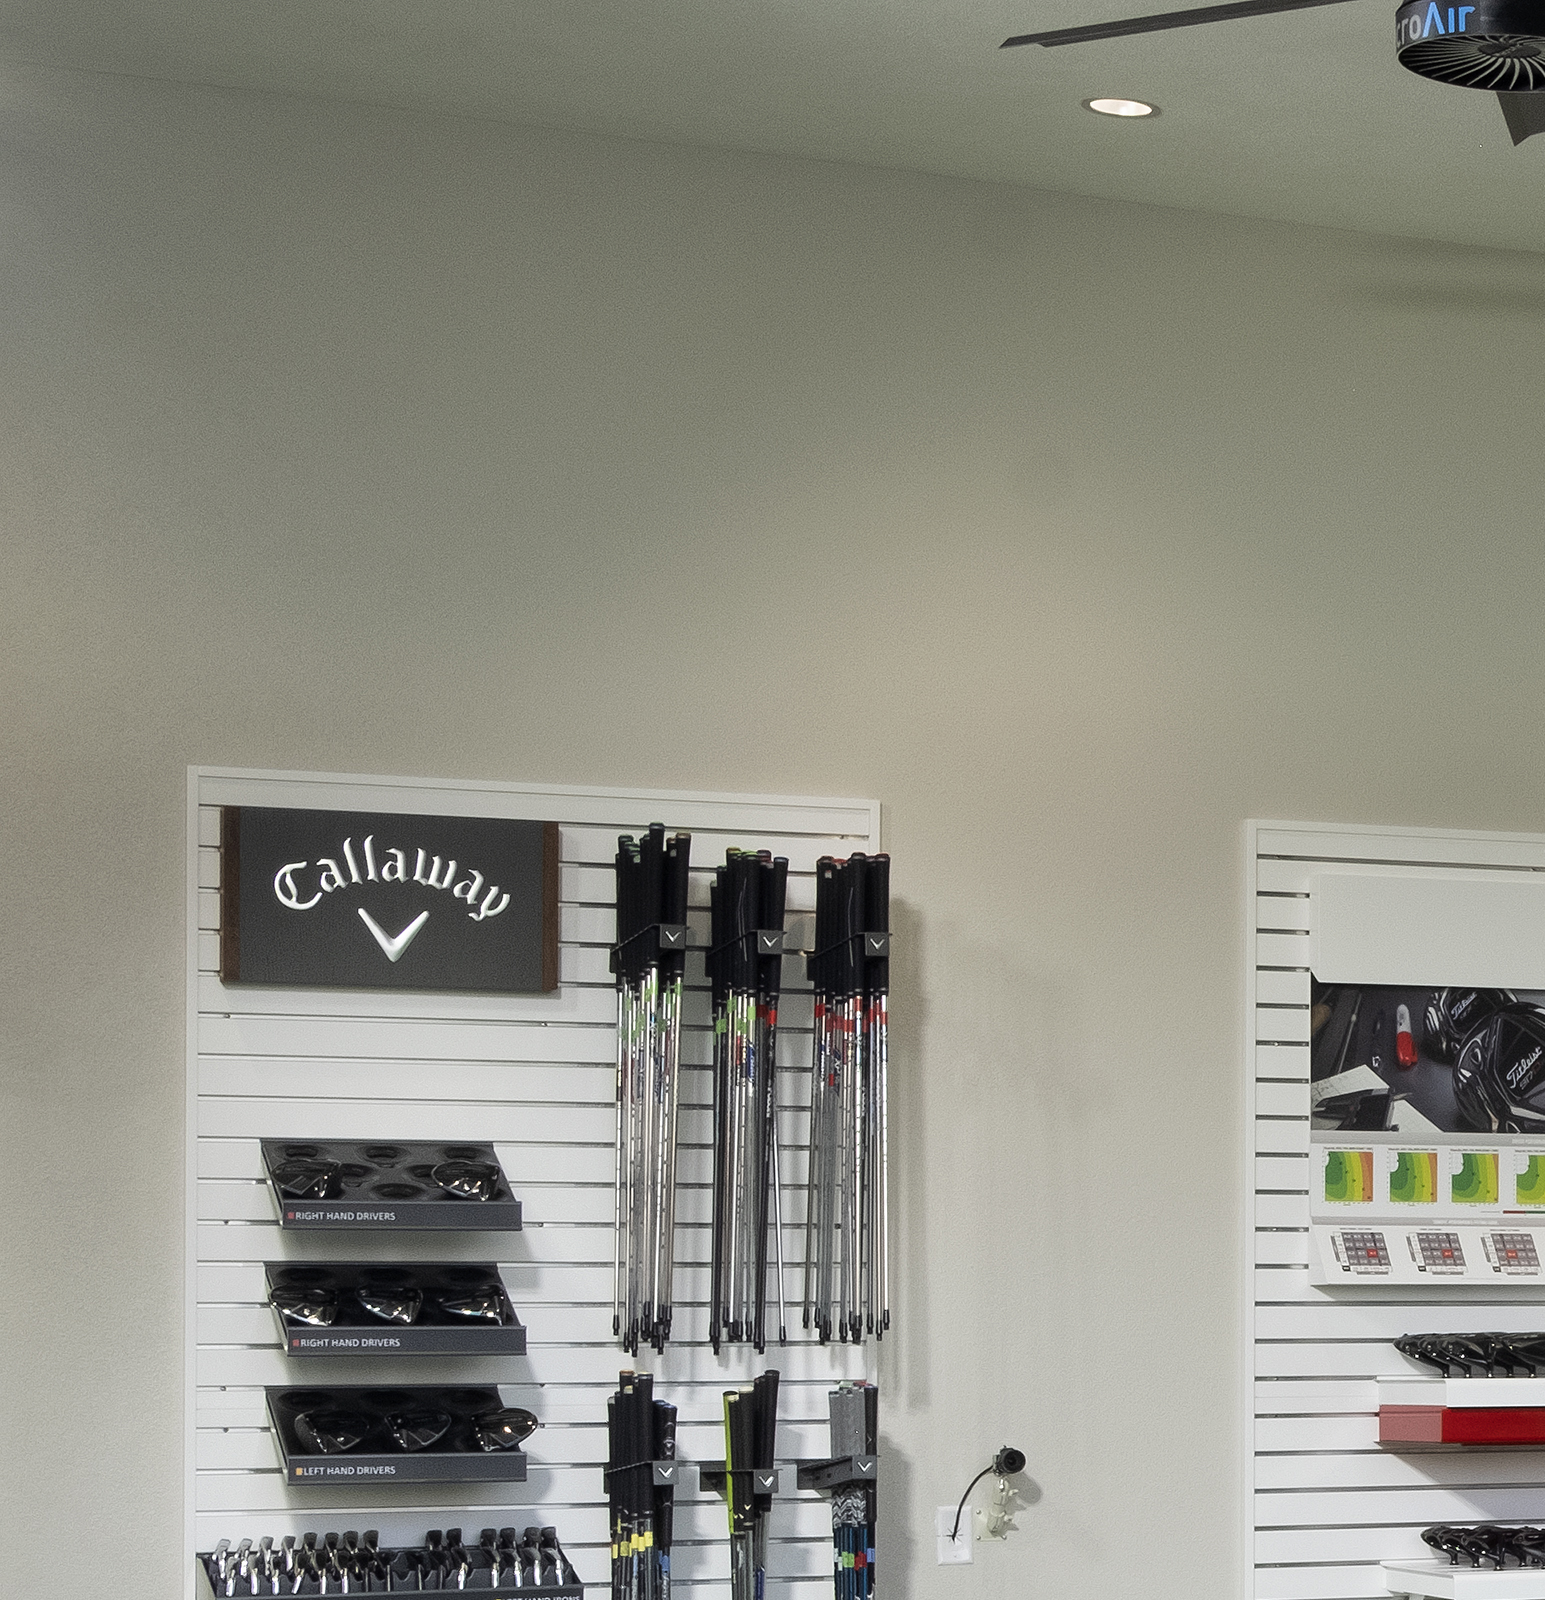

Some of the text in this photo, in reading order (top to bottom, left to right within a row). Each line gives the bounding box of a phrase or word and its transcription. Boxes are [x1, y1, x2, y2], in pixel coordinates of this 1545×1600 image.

[273, 834, 512, 922] Callaway
[1506, 1045, 1543, 1090] Titleist
[295, 1211, 397, 1221] RIGHT HAND DRIVERS
[300, 1338, 401, 1348] RIGHT HAND DRIVERS
[303, 1465, 397, 1476] LEFT HAND DRIVERS
